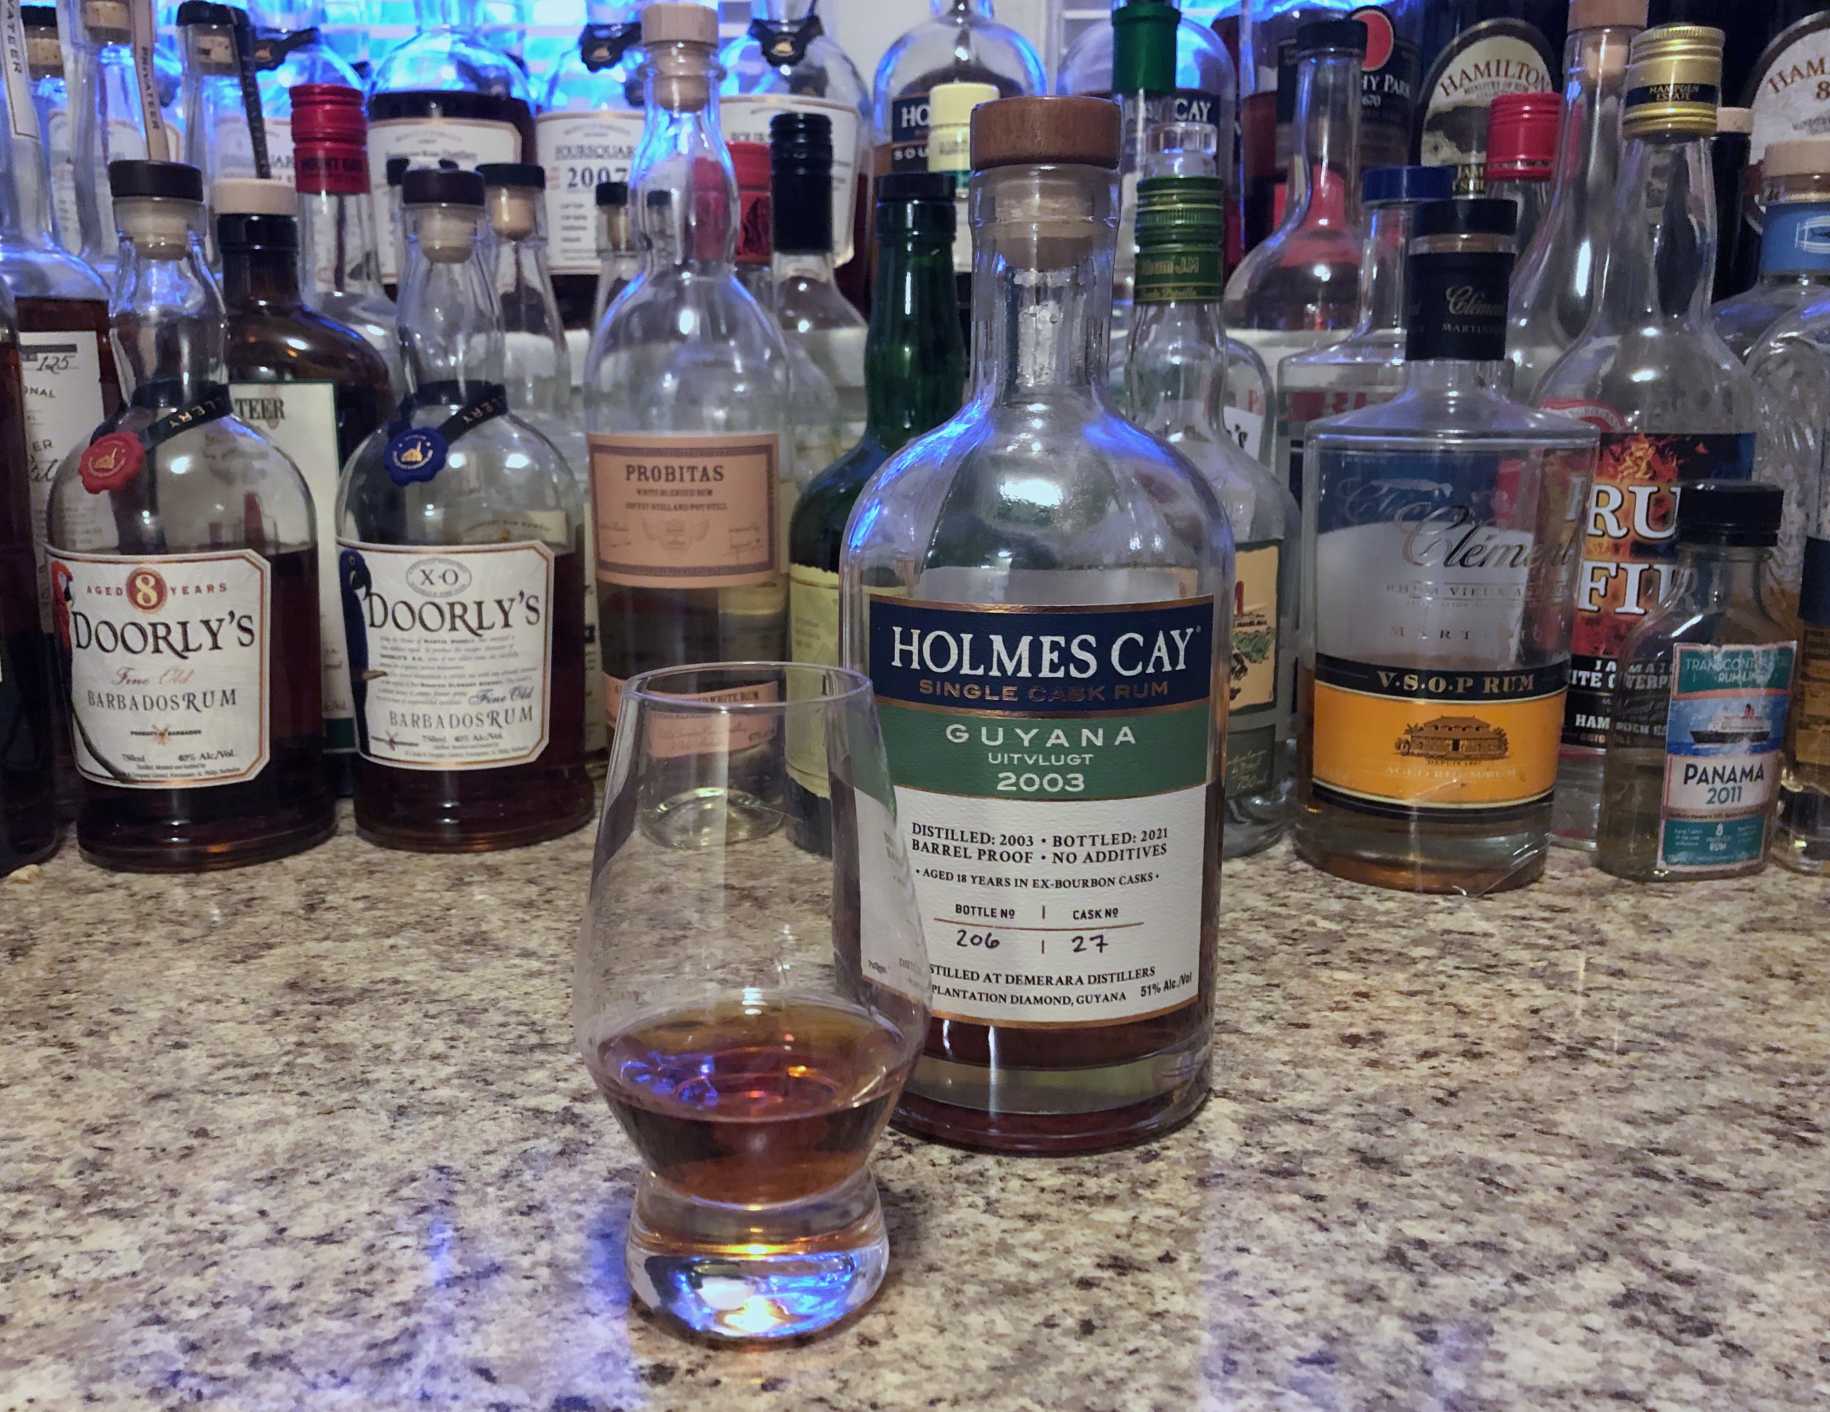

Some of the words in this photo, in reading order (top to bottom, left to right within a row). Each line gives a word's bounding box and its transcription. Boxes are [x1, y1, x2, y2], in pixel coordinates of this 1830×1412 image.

[1440, 58, 1550, 97] HAMILTON
[1174, 98, 1211, 122] CAY
[235, 398, 286, 420] TEER
[625, 464, 725, 482] PROBITAS
[1586, 484, 1681, 539] RU
[87, 585, 124, 597] AGED
[135, 572, 159, 605] 8
[170, 582, 228, 596] YEARS
[364, 590, 541, 638] DOORLY'S
[71, 610, 256, 660] DOORLY'S
[891, 625, 1099, 679] HOLMES
[1110, 627, 1194, 677] CAY
[1483, 672, 1535, 694] RUM
[1568, 669, 1602, 688] ITE
[87, 690, 182, 711] BARBADOS
[182, 688, 237, 713] RUM
[919, 679, 1018, 702] SINGLE
[1028, 686, 1105, 702] CASK
[1114, 680, 1169, 700] RUM
[389, 710, 484, 729] BARBADOS
[486, 704, 533, 729] RUM
[945, 724, 1137, 748] GUYANA
[987, 751, 1095, 767] UITVLUGT
[996, 772, 1086, 792] 2003
[1683, 763, 1765, 785] PANAMA
[1705, 786, 1744, 805] 2011
[911, 822, 996, 846] DISTILLED:
[999, 833, 1034, 848] 2003
[1052, 832, 1138, 848] BOTTLED:
[1140, 827, 1168, 843] 2021
[911, 838, 973, 860] BARREL
[977, 850, 1034, 864] PROOF
[1052, 852, 1078, 865] NO
[1082, 843, 1168, 864] ADDITIVES
[923, 868, 954, 882] AGED
[956, 873, 968, 884] 18
[971, 875, 1012, 888] YEARS
[1013, 877, 1029, 889] IN
[1032, 877, 1116, 889] EX-BOURBON
[1118, 871, 1154, 886] CASKS
[955, 903, 998, 919] BOTTLE
[1072, 908, 1103, 920] CASK
[955, 929, 1001, 950] 206
[1071, 934, 1109, 954] 27
[930, 963, 980, 982] STILLED
[982, 973, 1003, 985] AT
[1005, 974, 1084, 986] DEMERARA
[1087, 966, 1157, 985] DISTILLERS
[931, 984, 1008, 1004] PLANTATION
[1010, 995, 1075, 1007] DIAMOND,
[1076, 991, 1127, 1006] GUYANA
[1140, 983, 1162, 998] 51%
